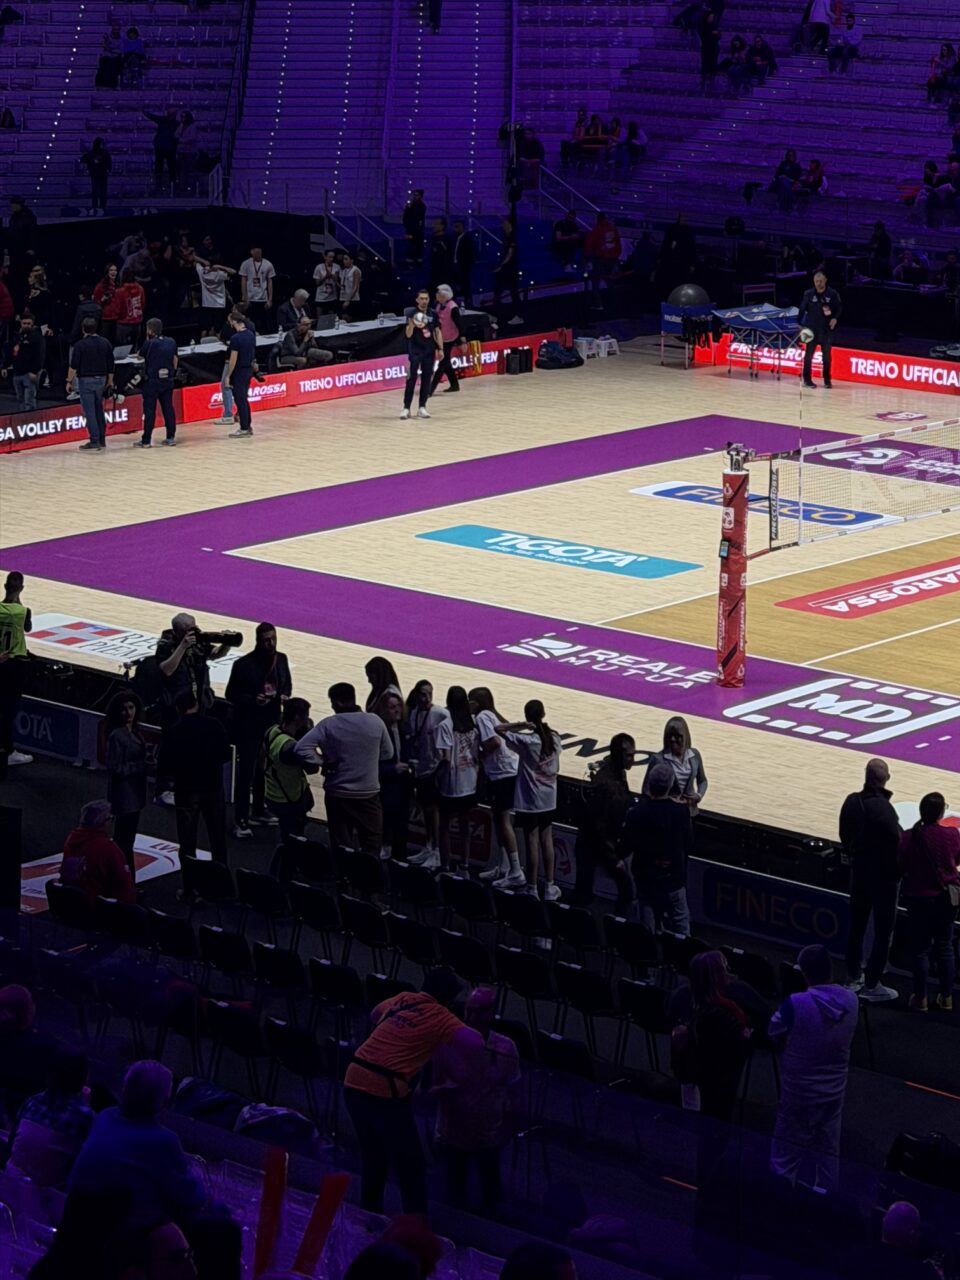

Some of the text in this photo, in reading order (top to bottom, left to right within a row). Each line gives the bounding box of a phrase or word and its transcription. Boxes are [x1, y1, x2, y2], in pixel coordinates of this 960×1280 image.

[299, 376, 333, 392] TRENO
[335, 370, 383, 387] UFFICIALE
[384, 366, 408, 379] DELL
[850, 357, 898, 378] TRENO
[17, 418, 62, 439] VOLLEY
[558, 656, 695, 689] MUTUA
[579, 648, 720, 683] REALE
[788, 693, 913, 723] MD
[715, 880, 840, 940] FINECO
